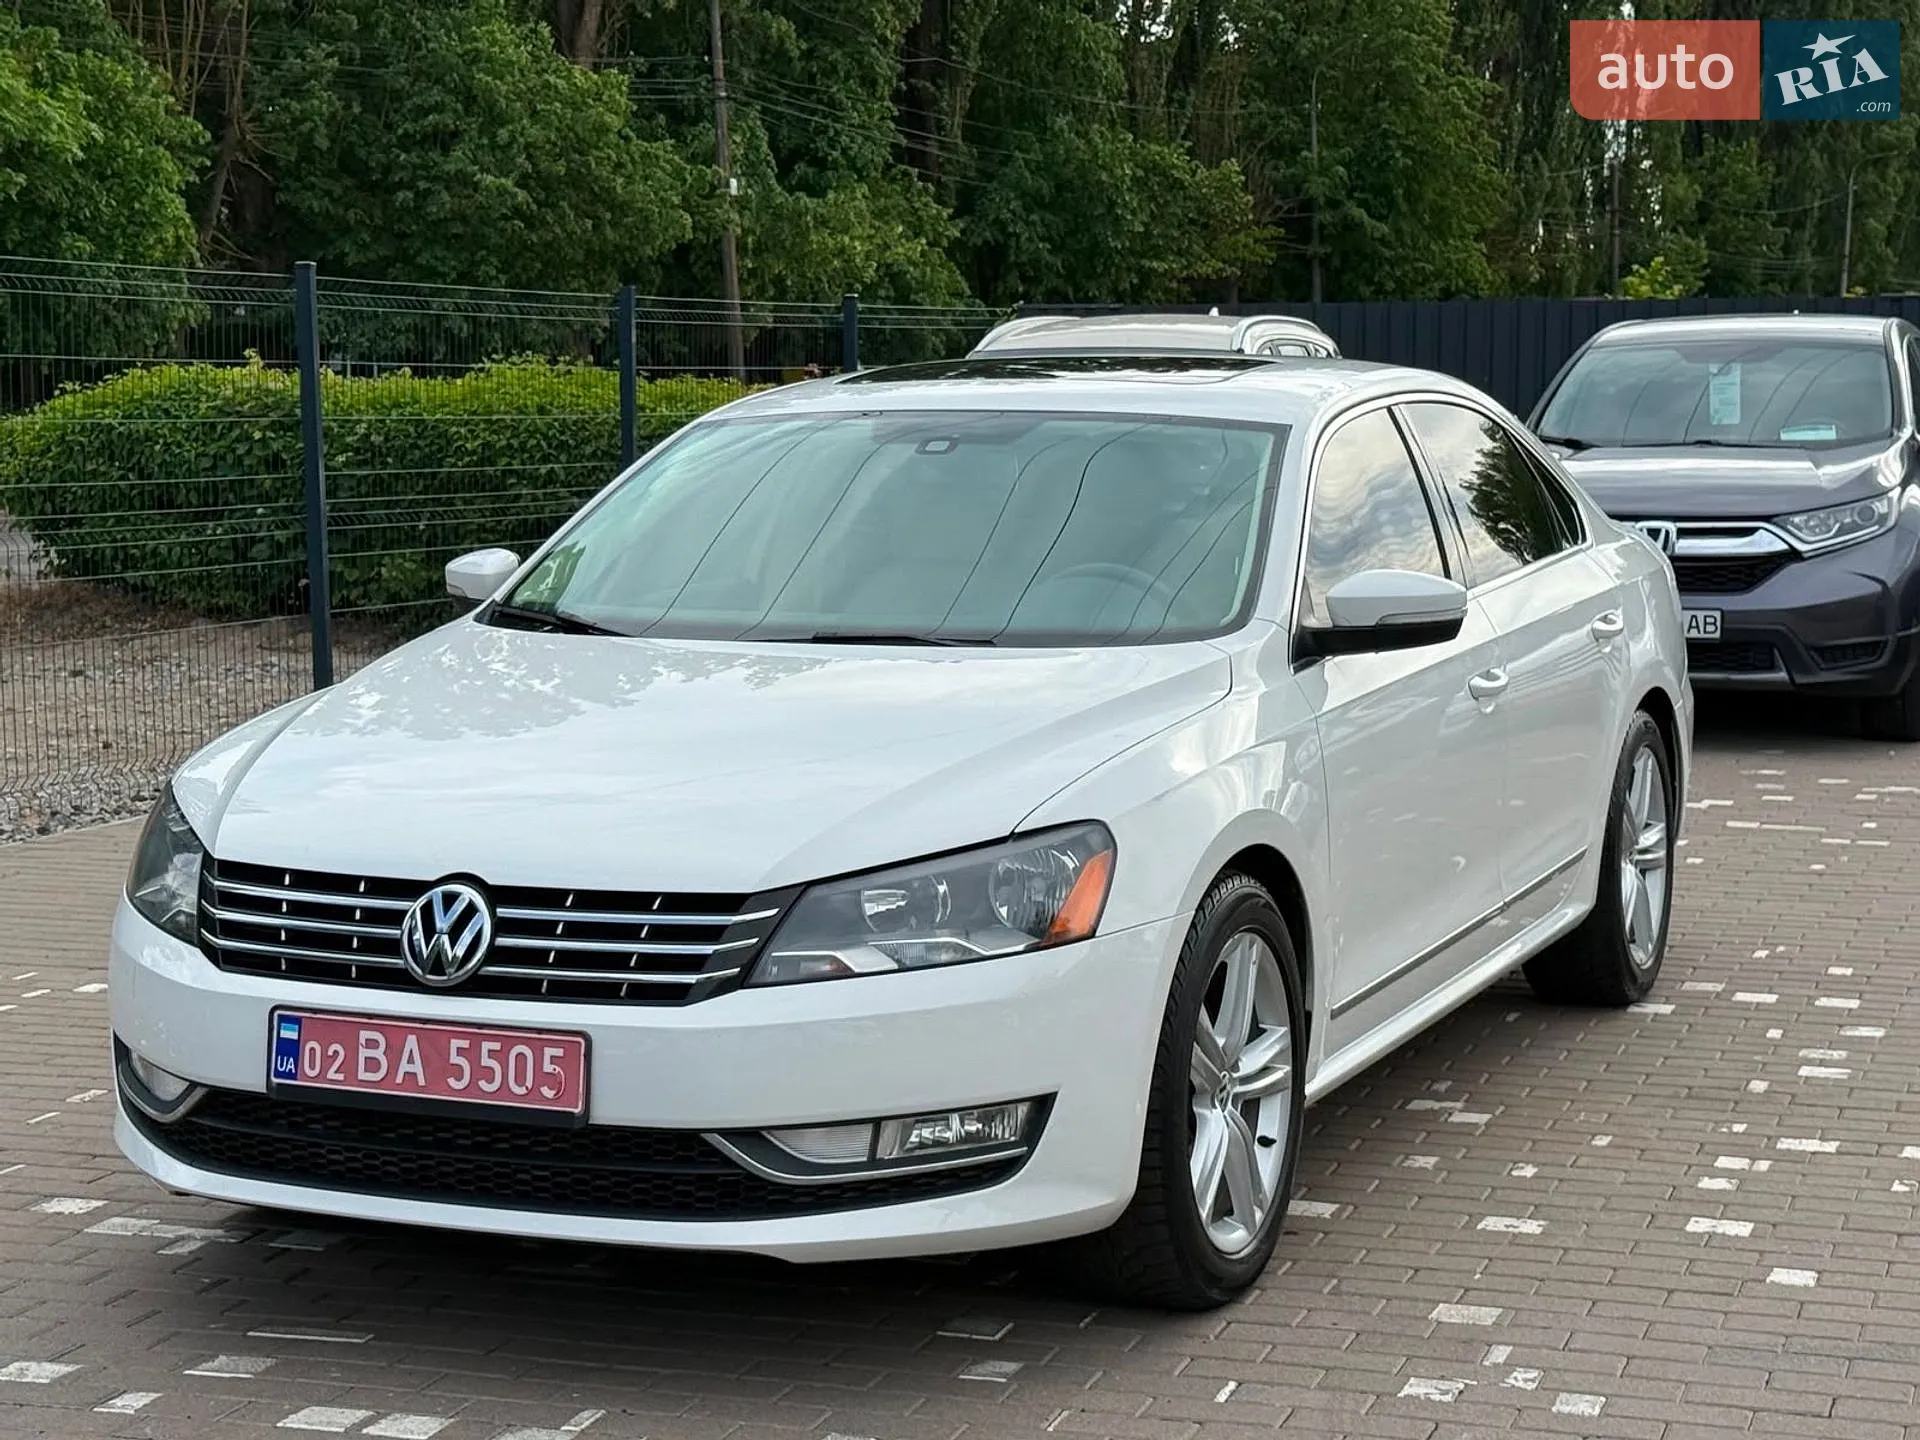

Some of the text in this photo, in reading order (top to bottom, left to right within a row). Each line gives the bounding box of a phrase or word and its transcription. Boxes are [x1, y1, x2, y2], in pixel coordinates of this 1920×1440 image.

[1687, 614, 1719, 635] AB
[277, 1056, 296, 1074] UA
[302, 1030, 566, 1100] 02 BA 5505
